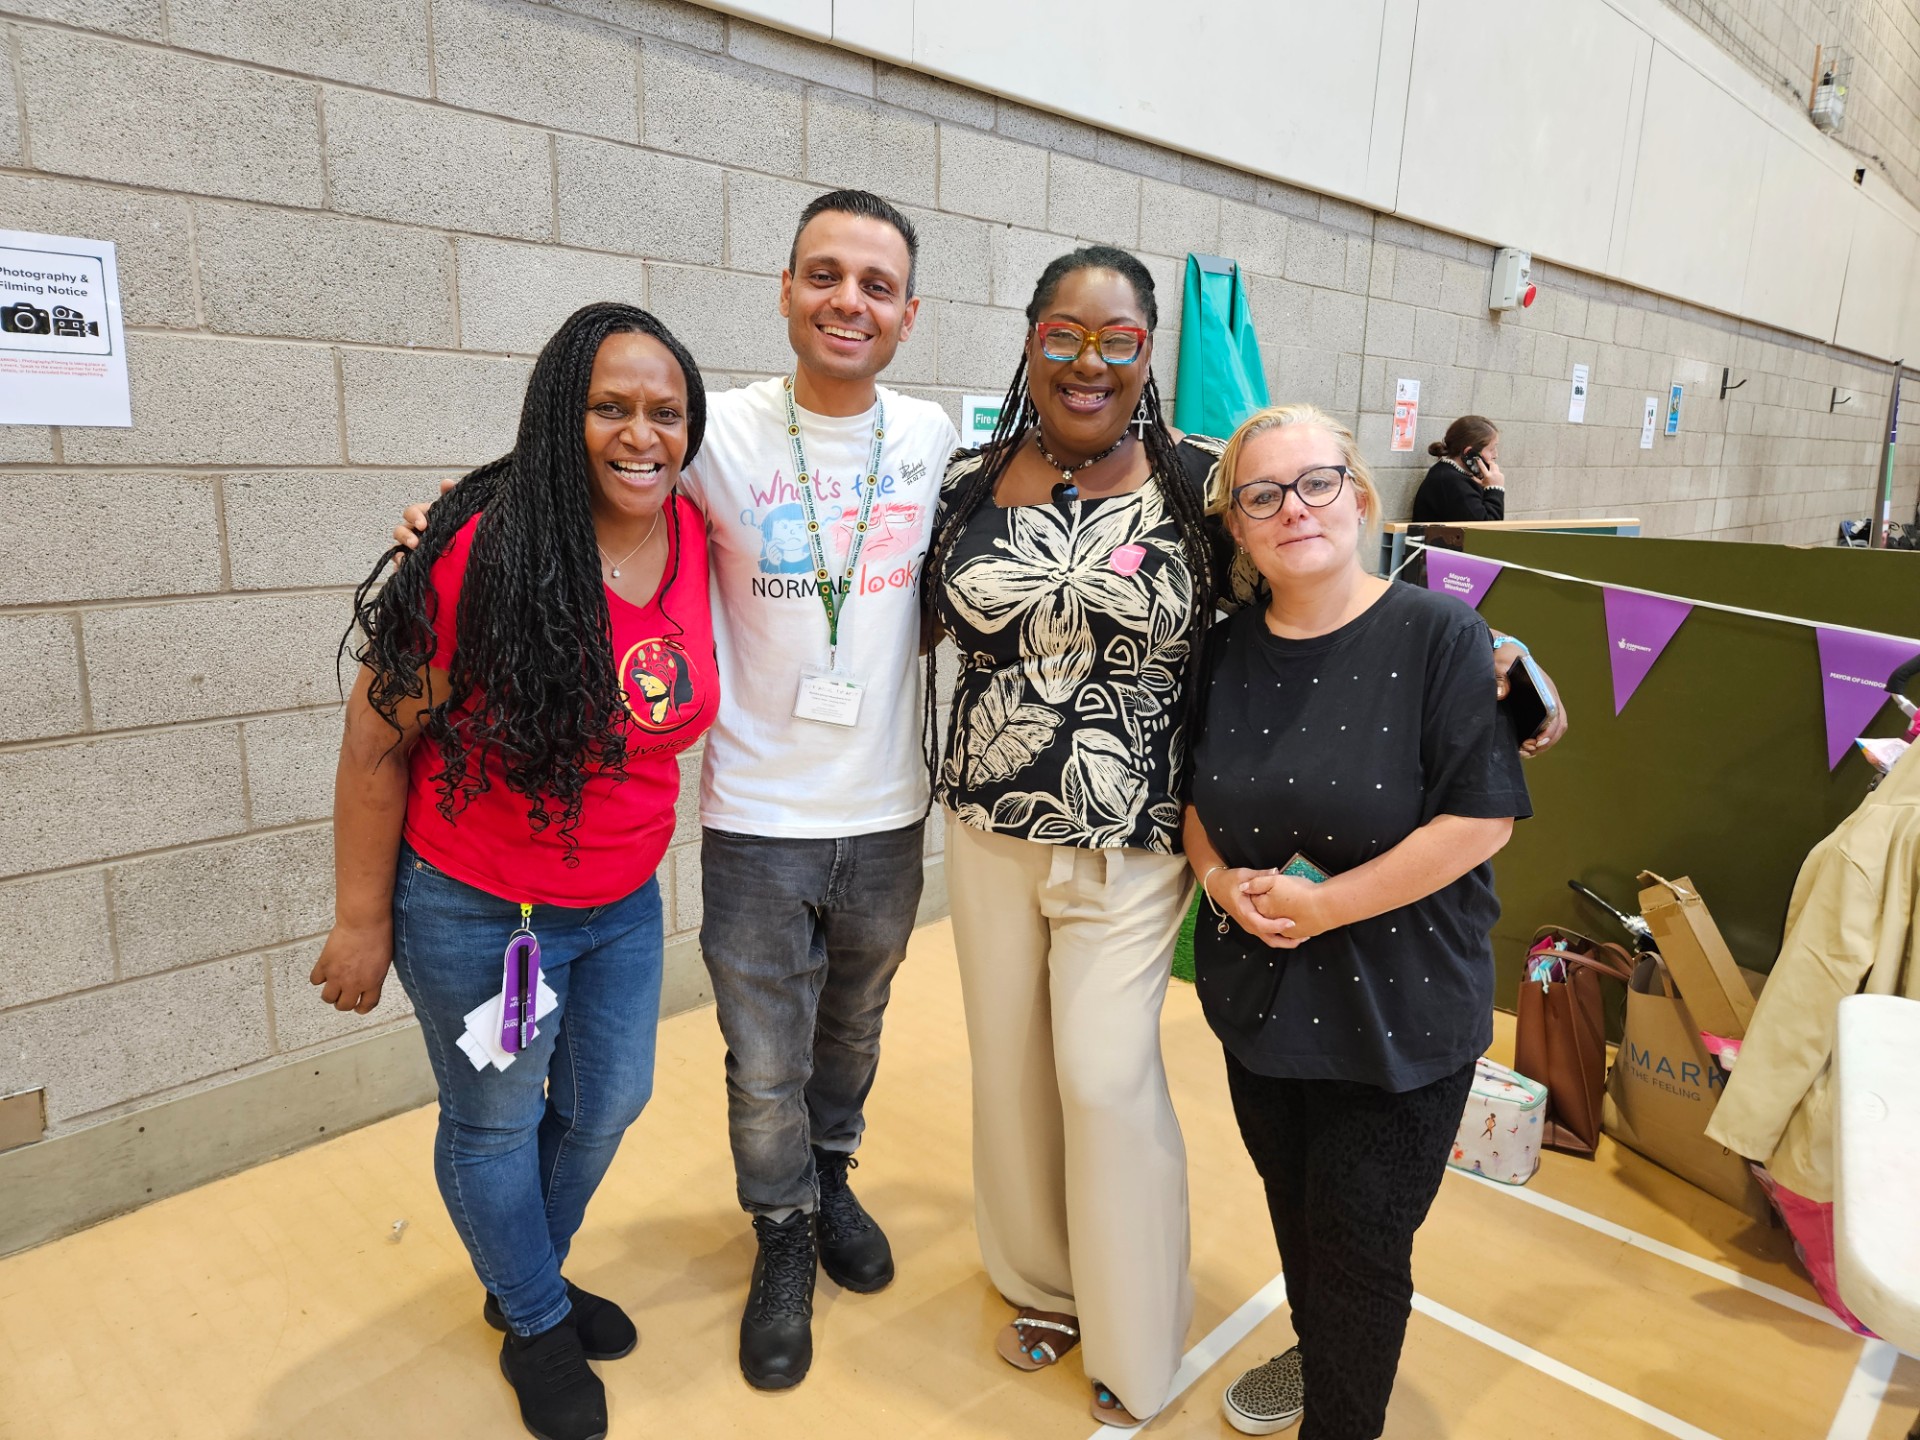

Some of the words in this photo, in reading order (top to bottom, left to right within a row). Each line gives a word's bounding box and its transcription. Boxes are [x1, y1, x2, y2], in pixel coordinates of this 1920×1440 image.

[80, 274, 89, 283] &
[48, 285, 88, 296] Notice
[975, 413, 992, 425] Fire
[804, 485, 817, 521] SUNFLOWER
[863, 487, 875, 522] SUNFLOWER
[815, 533, 826, 568] SUNFLOWER
[1442, 576, 1475, 589] Community
[1448, 572, 1471, 583] Mayor's
[1444, 583, 1470, 594] Weekend
[1829, 672, 1851, 682] MAYOR
[1630, 1066, 1649, 1084] THE
[1652, 1076, 1702, 1102] FEELING
